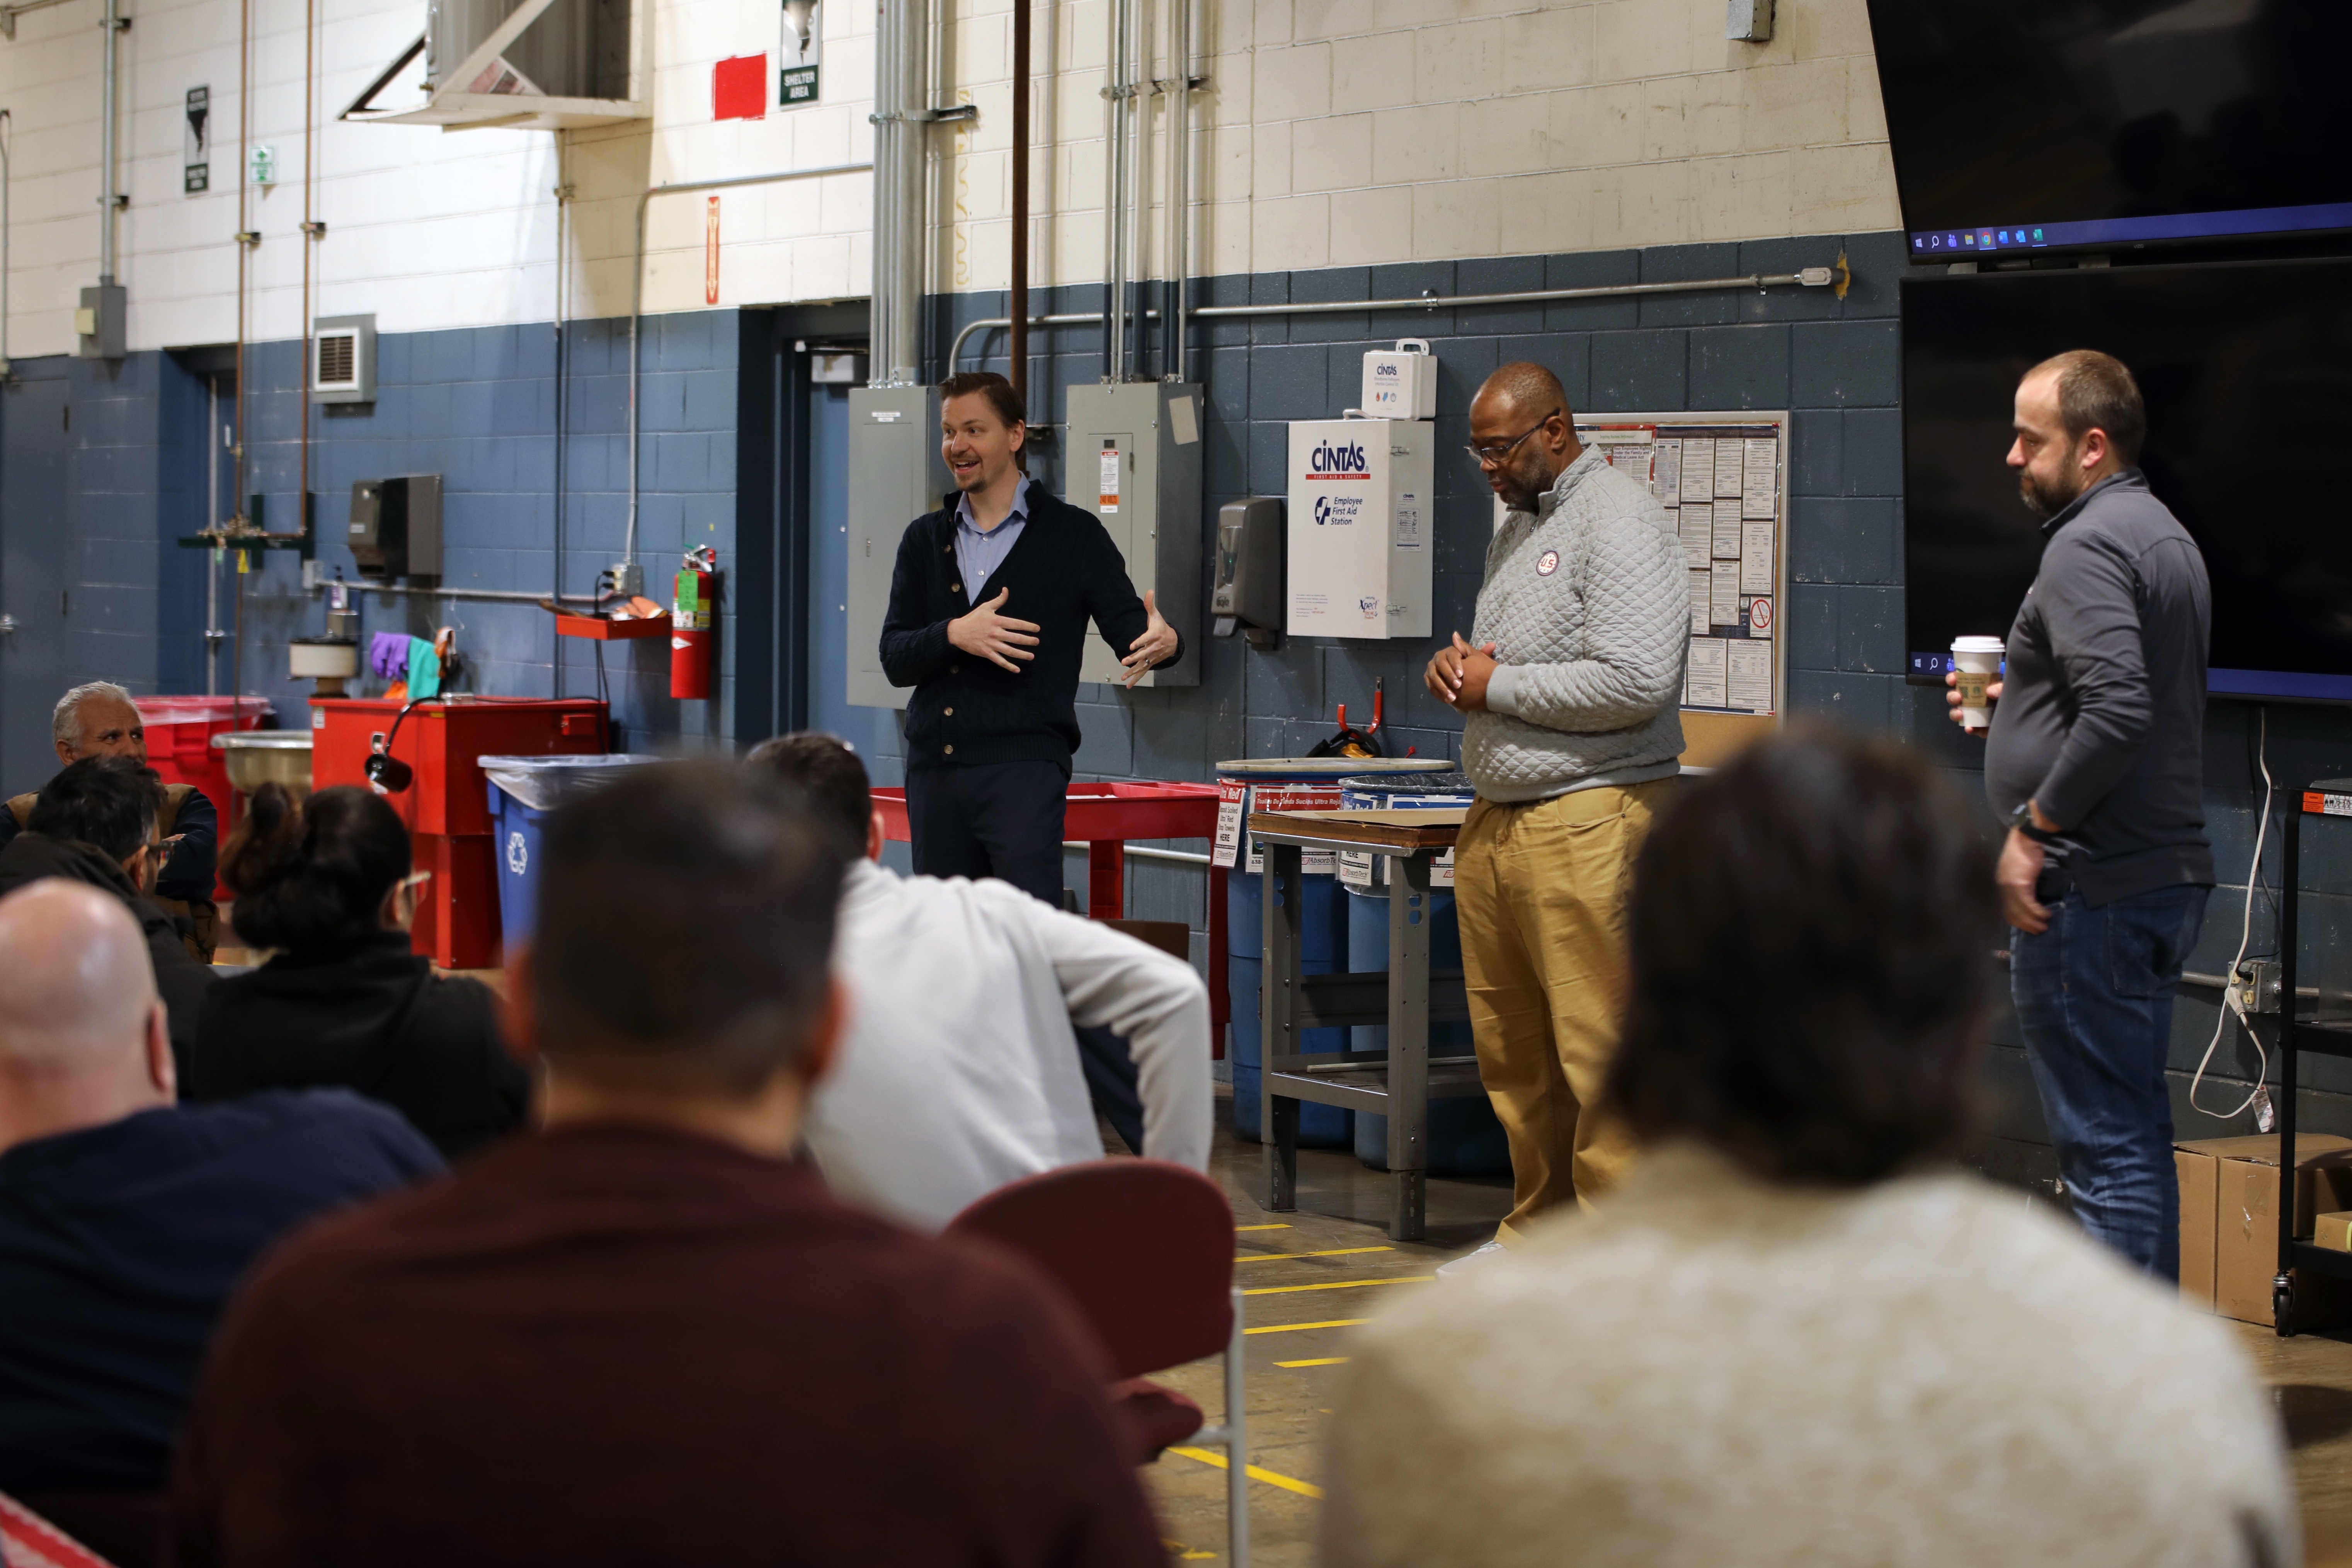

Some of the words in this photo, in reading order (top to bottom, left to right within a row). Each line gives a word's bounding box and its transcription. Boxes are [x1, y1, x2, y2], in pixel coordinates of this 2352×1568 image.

[784, 71, 815, 87] SHELTER
[790, 85, 809, 99] AREA
[1334, 497, 1363, 507] Employee
[1228, 788, 1241, 800] Red
[1220, 833, 1230, 842] HERE
